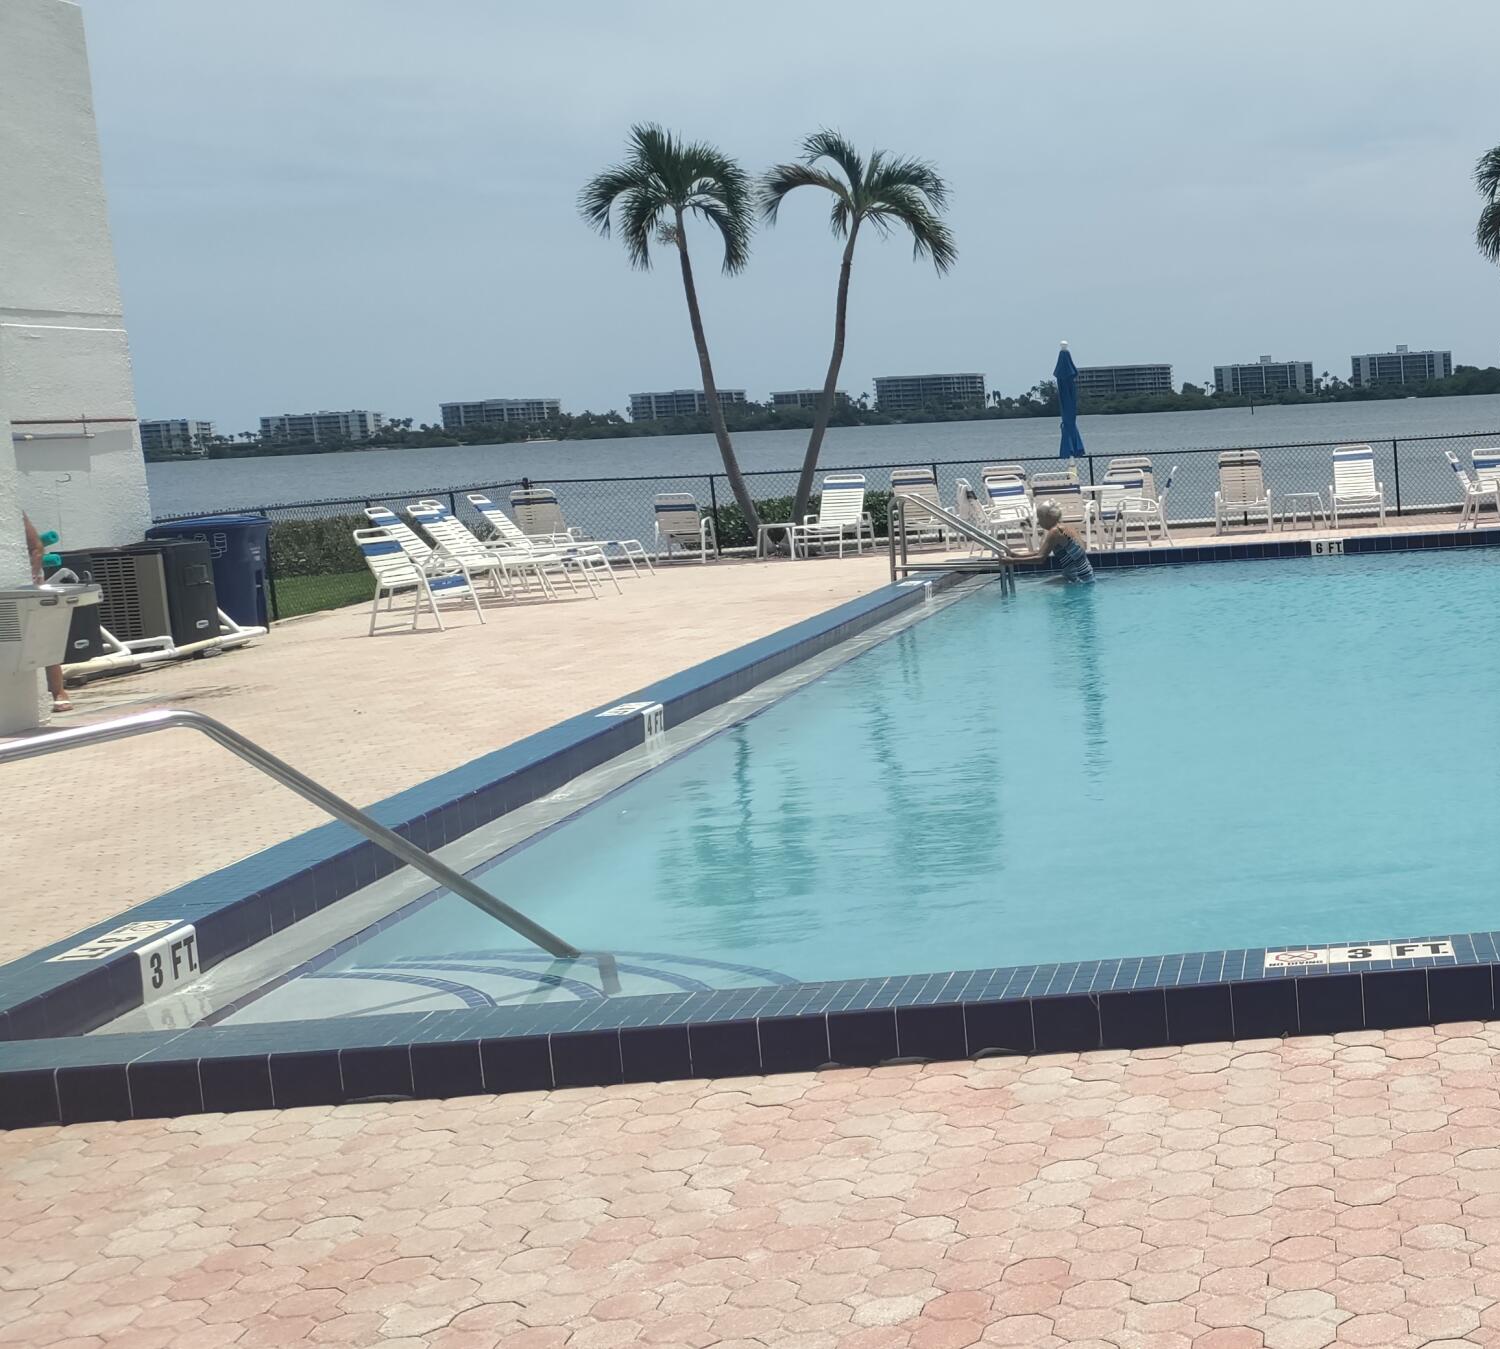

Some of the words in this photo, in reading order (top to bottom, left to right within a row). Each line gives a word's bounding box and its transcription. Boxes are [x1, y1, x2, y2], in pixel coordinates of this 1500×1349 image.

[1315, 542, 1323, 554] 6
[1347, 948, 1372, 959] 3
[149, 952, 164, 990] 3
